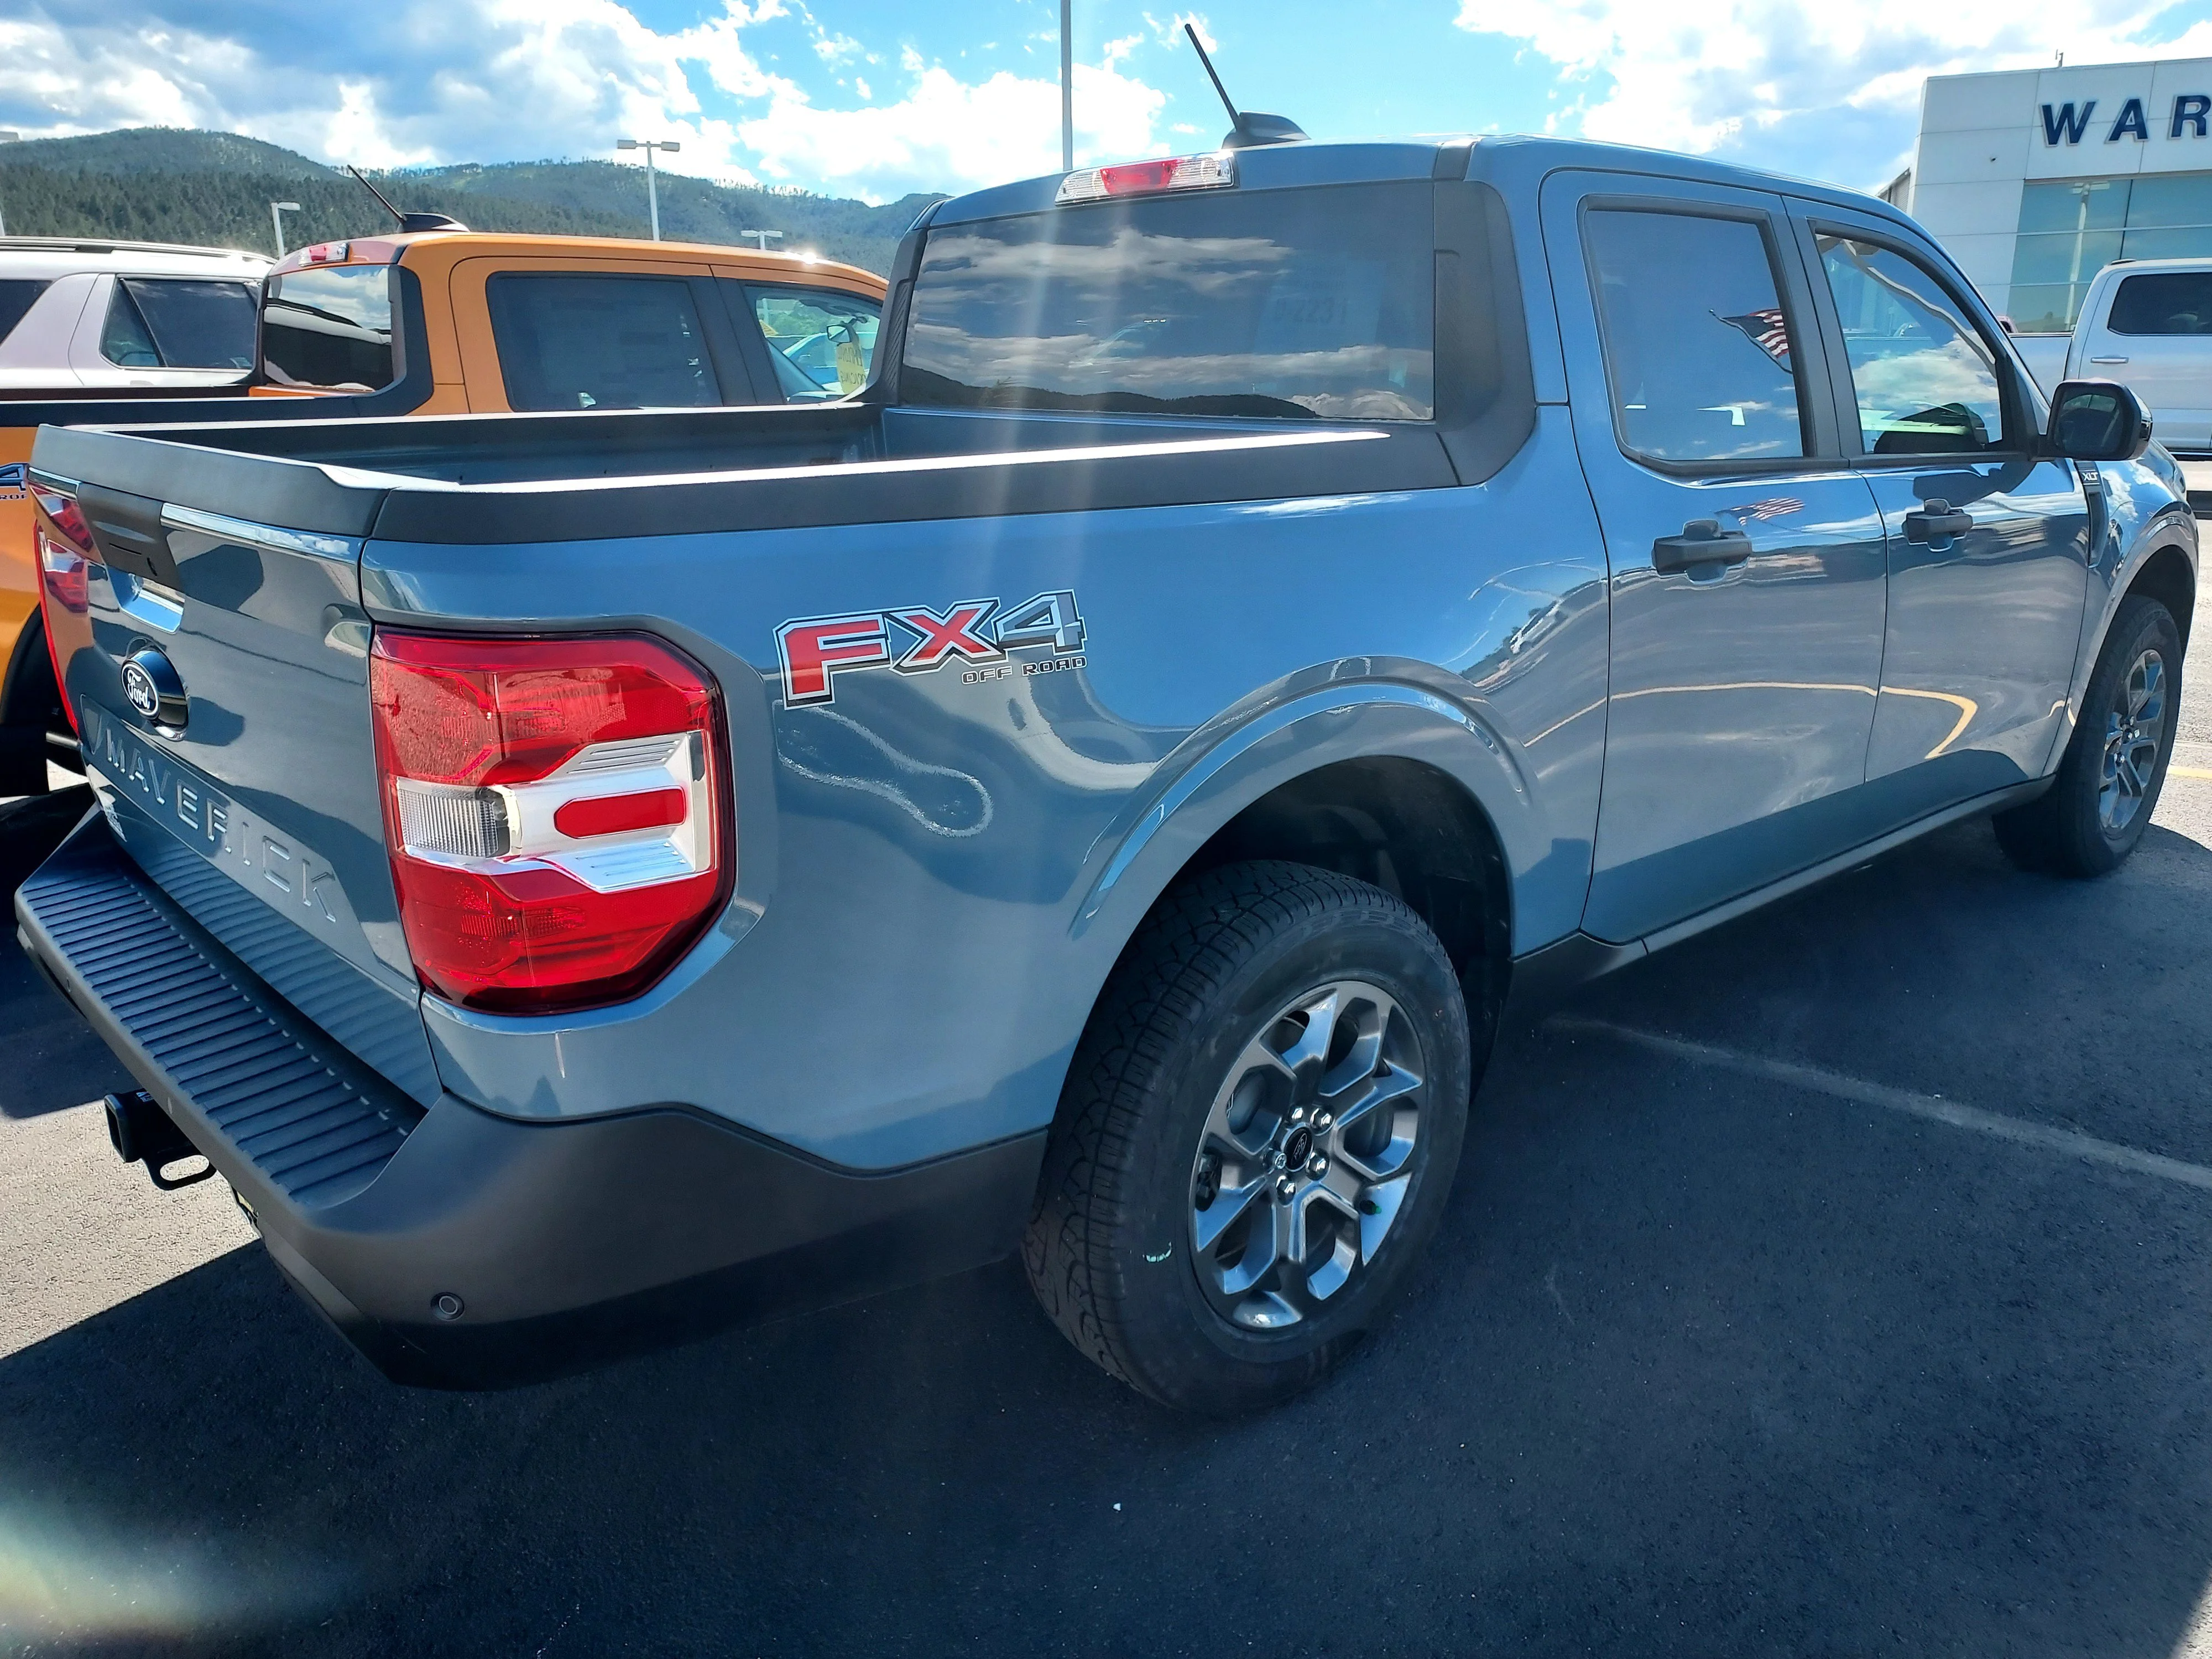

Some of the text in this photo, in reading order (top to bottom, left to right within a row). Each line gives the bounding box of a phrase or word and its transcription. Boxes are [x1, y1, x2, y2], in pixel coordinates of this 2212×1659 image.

[2039, 94, 2212, 147] WAR
[2082, 472, 2099, 481] XLT
[773, 588, 1088, 710] FX4
[962, 656, 1087, 685] OFF ROAD
[127, 668, 152, 710] Ford
[106, 728, 336, 922] MAVERICK
